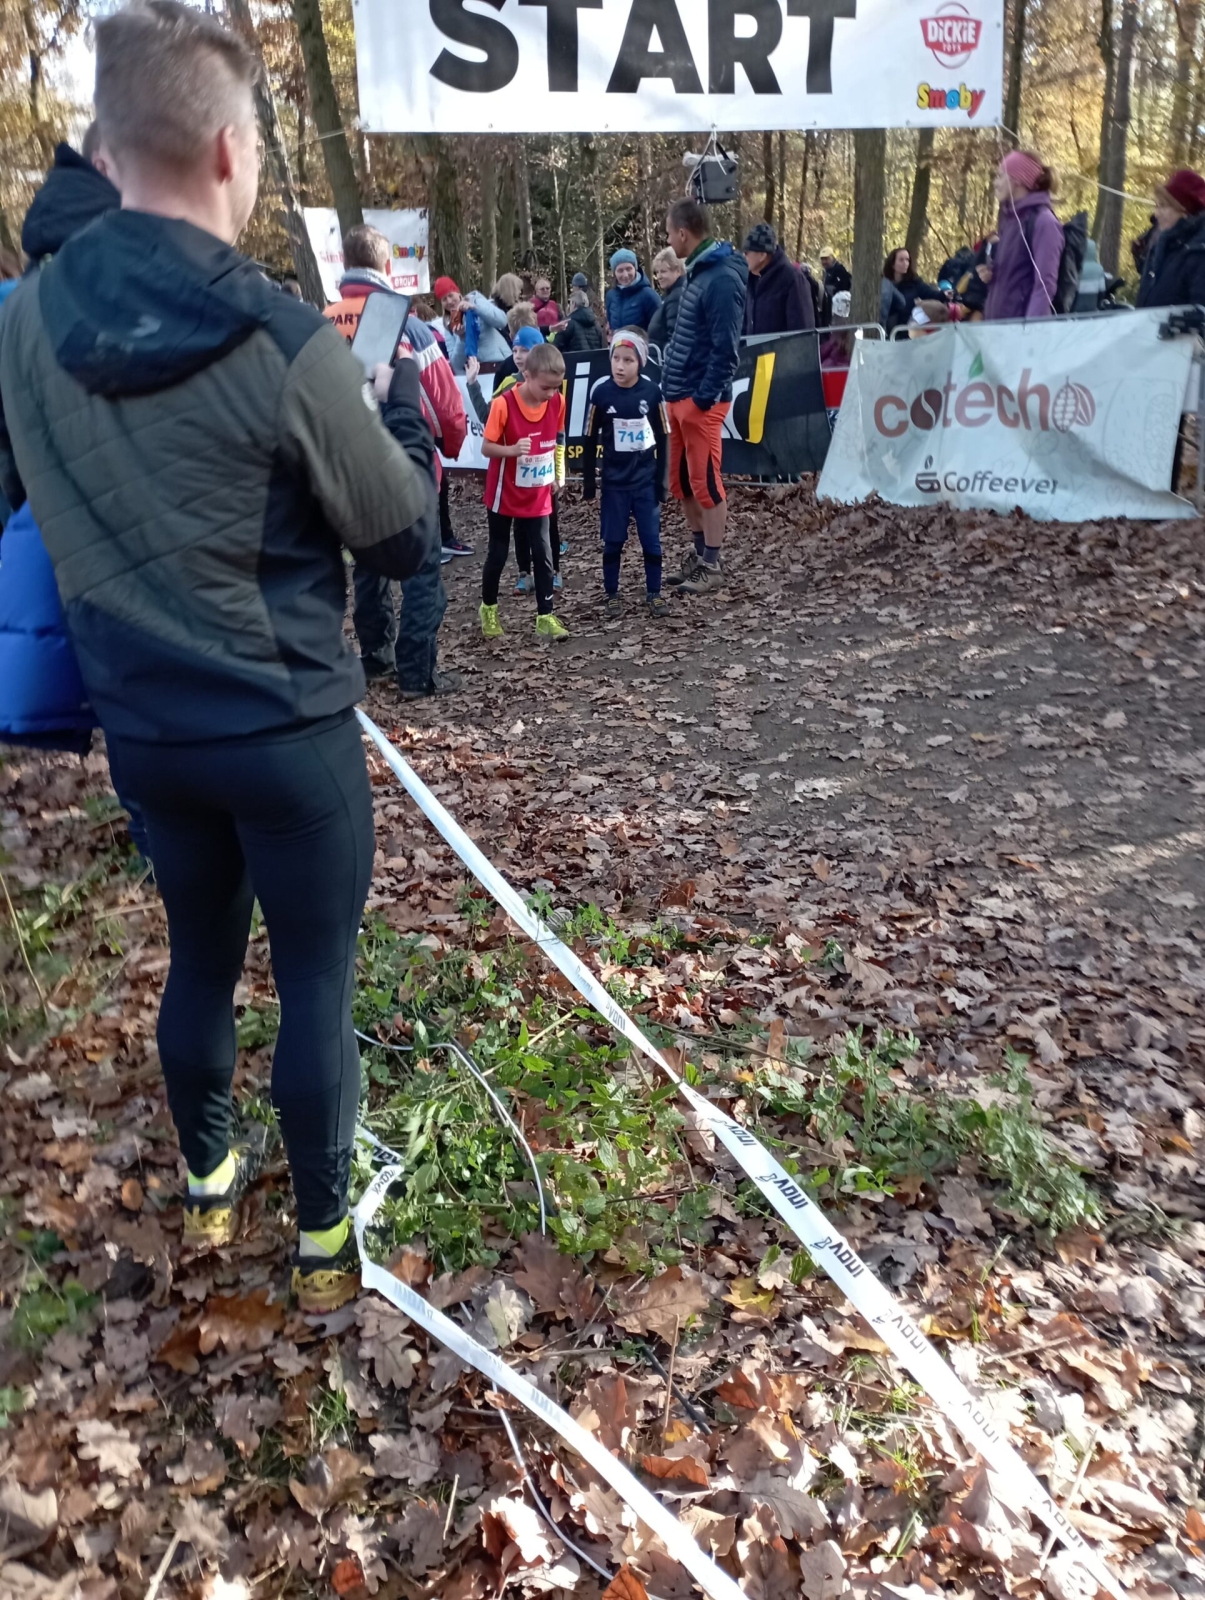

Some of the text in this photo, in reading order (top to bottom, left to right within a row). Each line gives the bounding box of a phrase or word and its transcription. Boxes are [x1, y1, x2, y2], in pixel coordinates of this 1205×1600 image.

[428, 0, 858, 95] START
[942, 42, 962, 52] TOYS
[917, 82, 985, 119] Smoby
[393, 243, 425, 262] Smoby
[394, 276, 416, 288] GROUP
[520, 463, 553, 478] 7144
